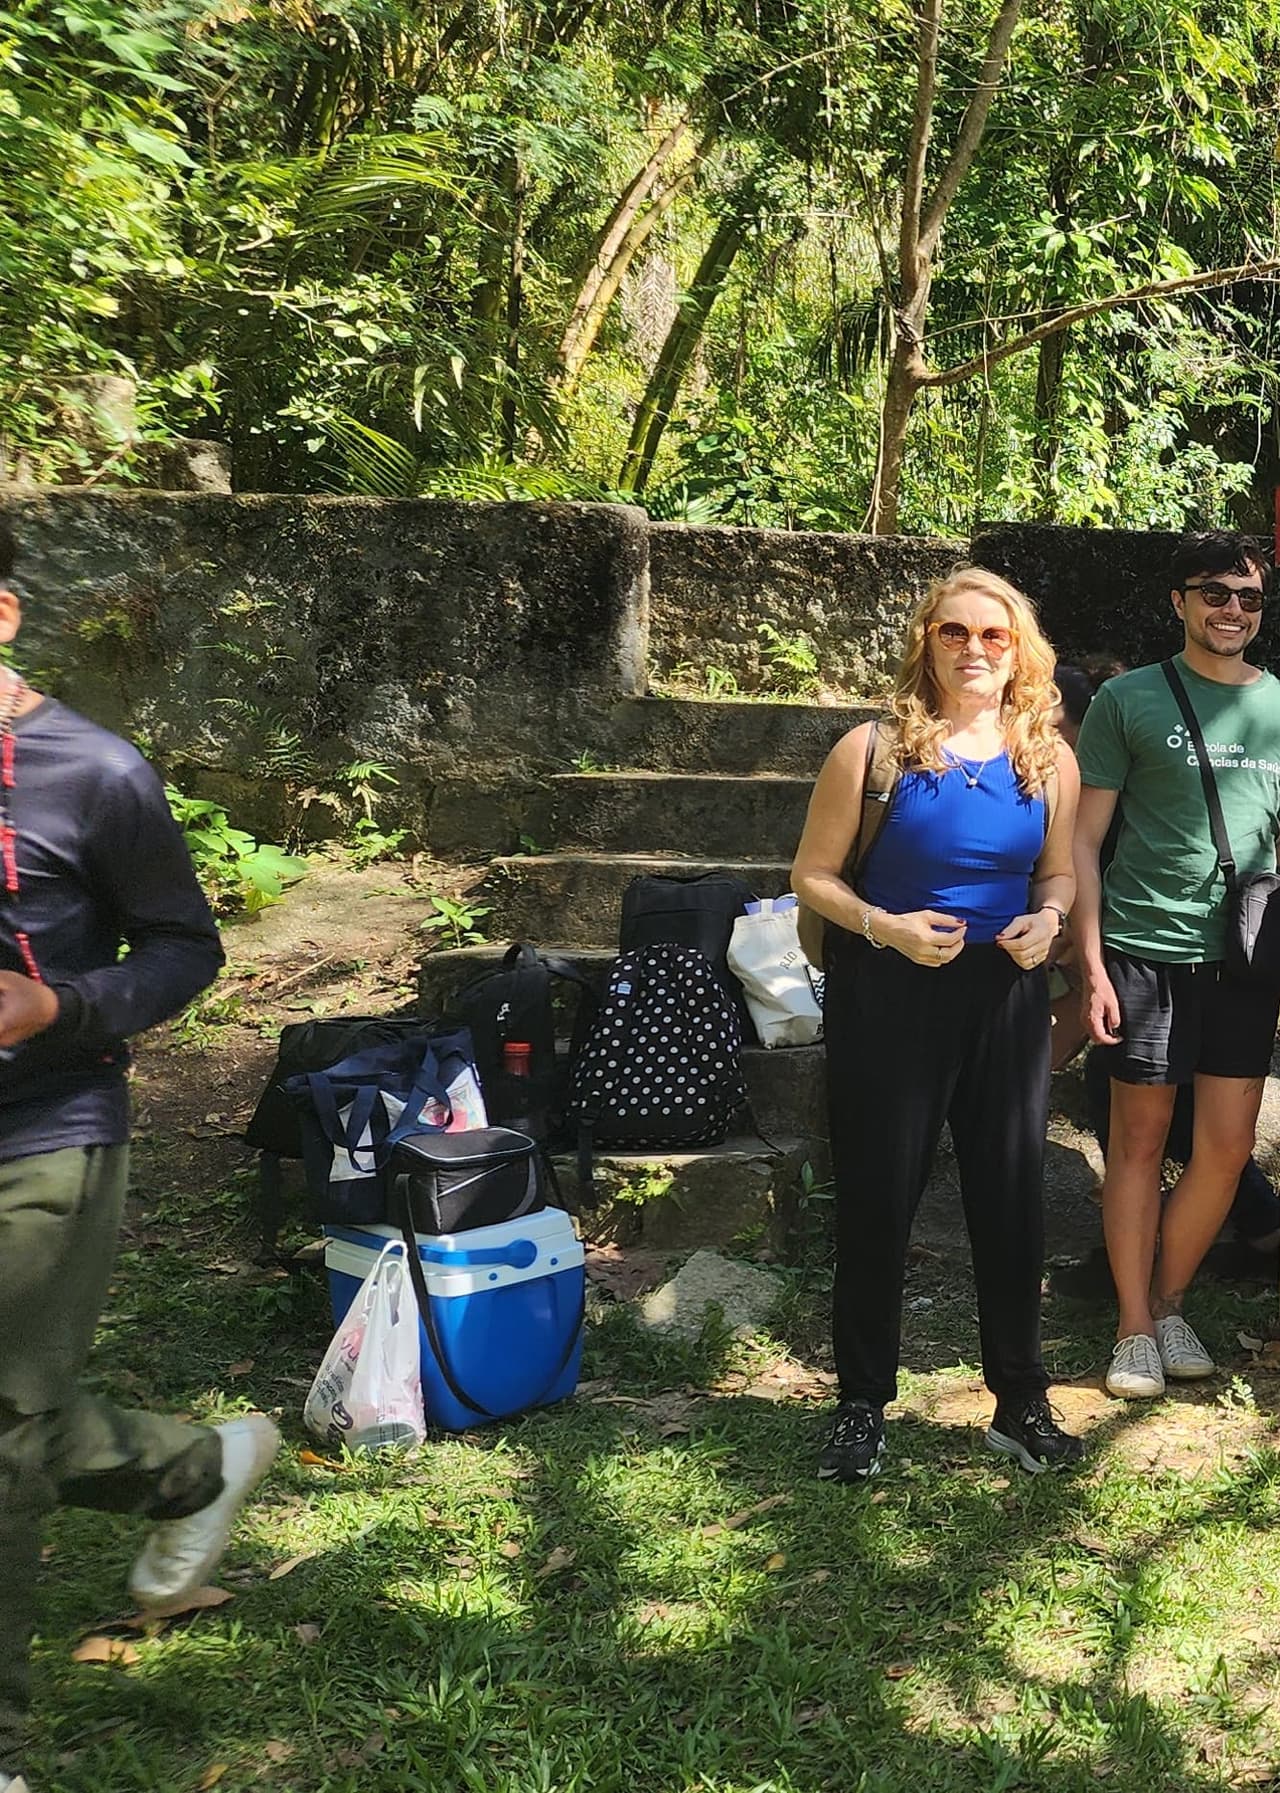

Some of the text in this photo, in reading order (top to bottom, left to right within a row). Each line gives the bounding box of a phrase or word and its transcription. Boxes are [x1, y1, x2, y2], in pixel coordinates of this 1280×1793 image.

[1187, 741, 1245, 754] Ecola de
[1240, 757, 1257, 769] da
